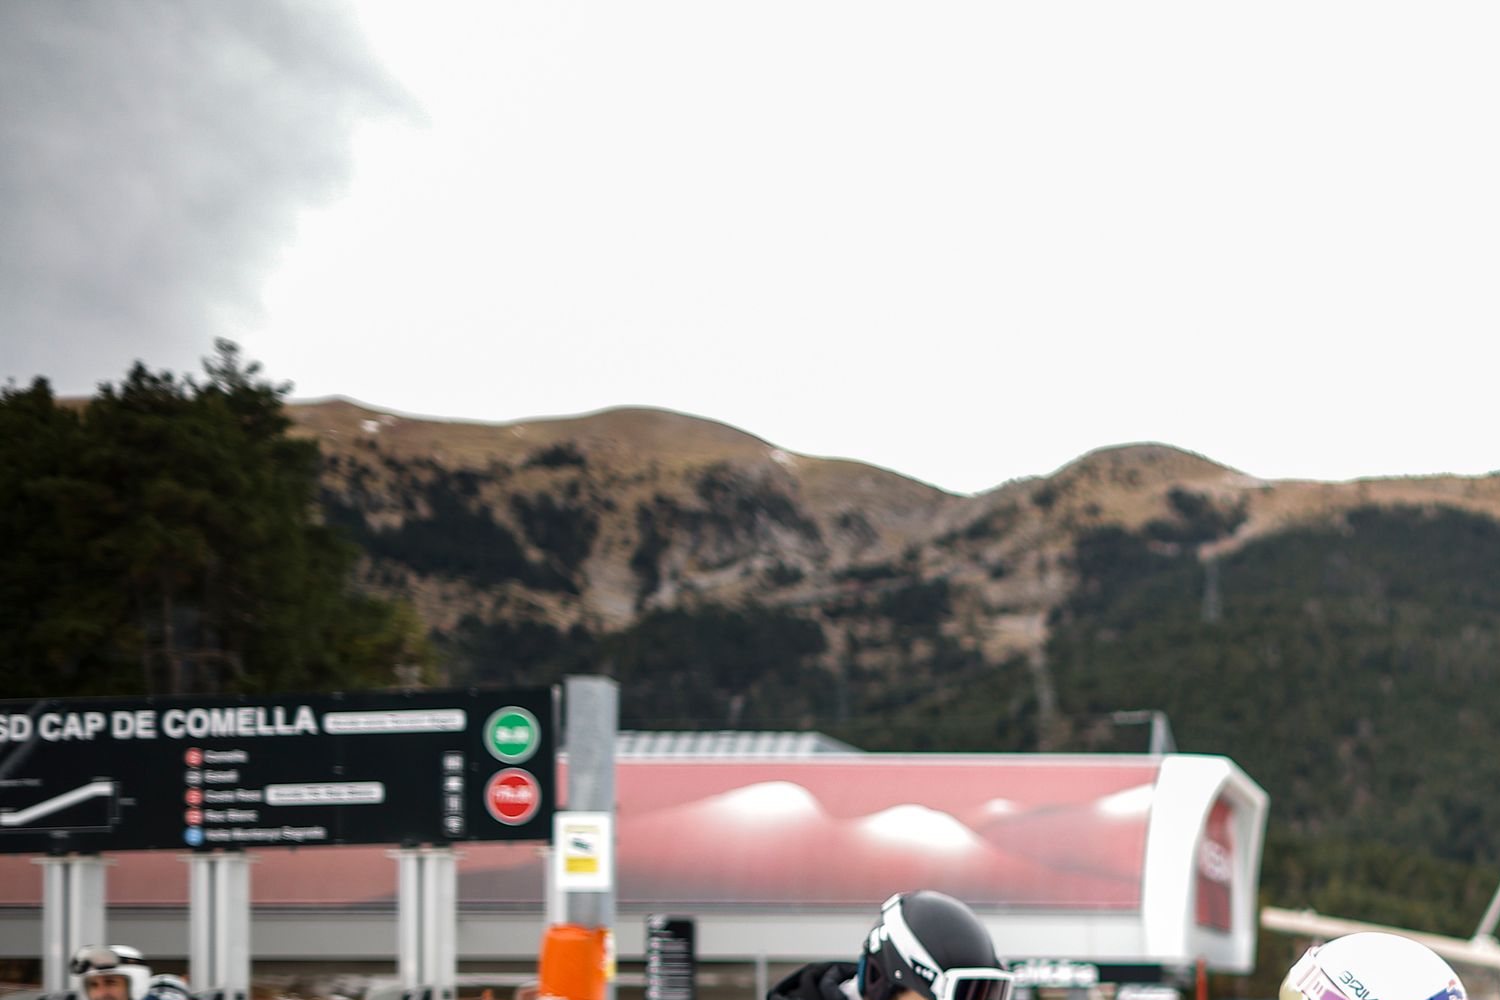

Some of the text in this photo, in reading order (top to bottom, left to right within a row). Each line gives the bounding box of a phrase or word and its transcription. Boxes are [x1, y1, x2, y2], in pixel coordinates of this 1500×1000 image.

[39, 712, 107, 741] CAP
[110, 710, 158, 740] DE
[162, 704, 319, 740] COMELLA
